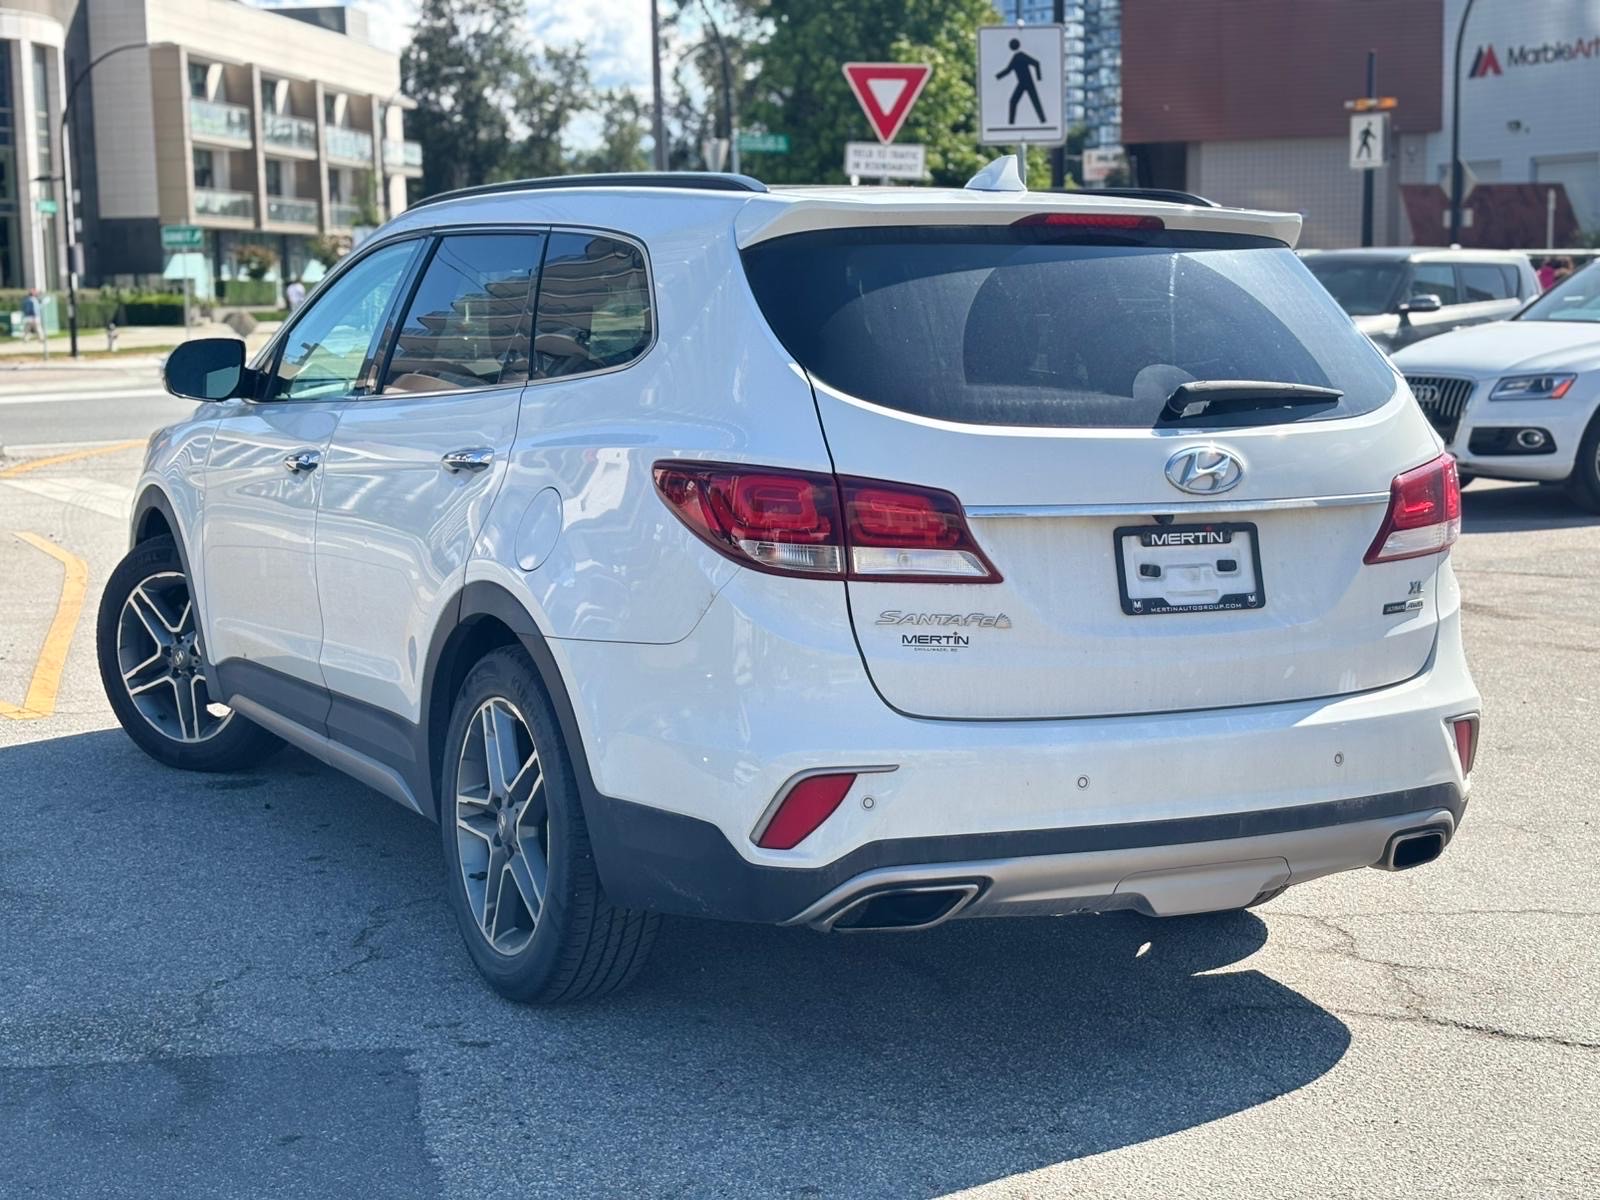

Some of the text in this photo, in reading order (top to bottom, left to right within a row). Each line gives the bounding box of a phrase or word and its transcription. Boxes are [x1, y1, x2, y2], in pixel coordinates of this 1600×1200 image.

[1151, 530, 1223, 545] MERTIN
[1408, 580, 1424, 594] XL
[1150, 603, 1242, 613] MERTINAUTOGROUP.COM
[902, 631, 969, 645] MERTIN
